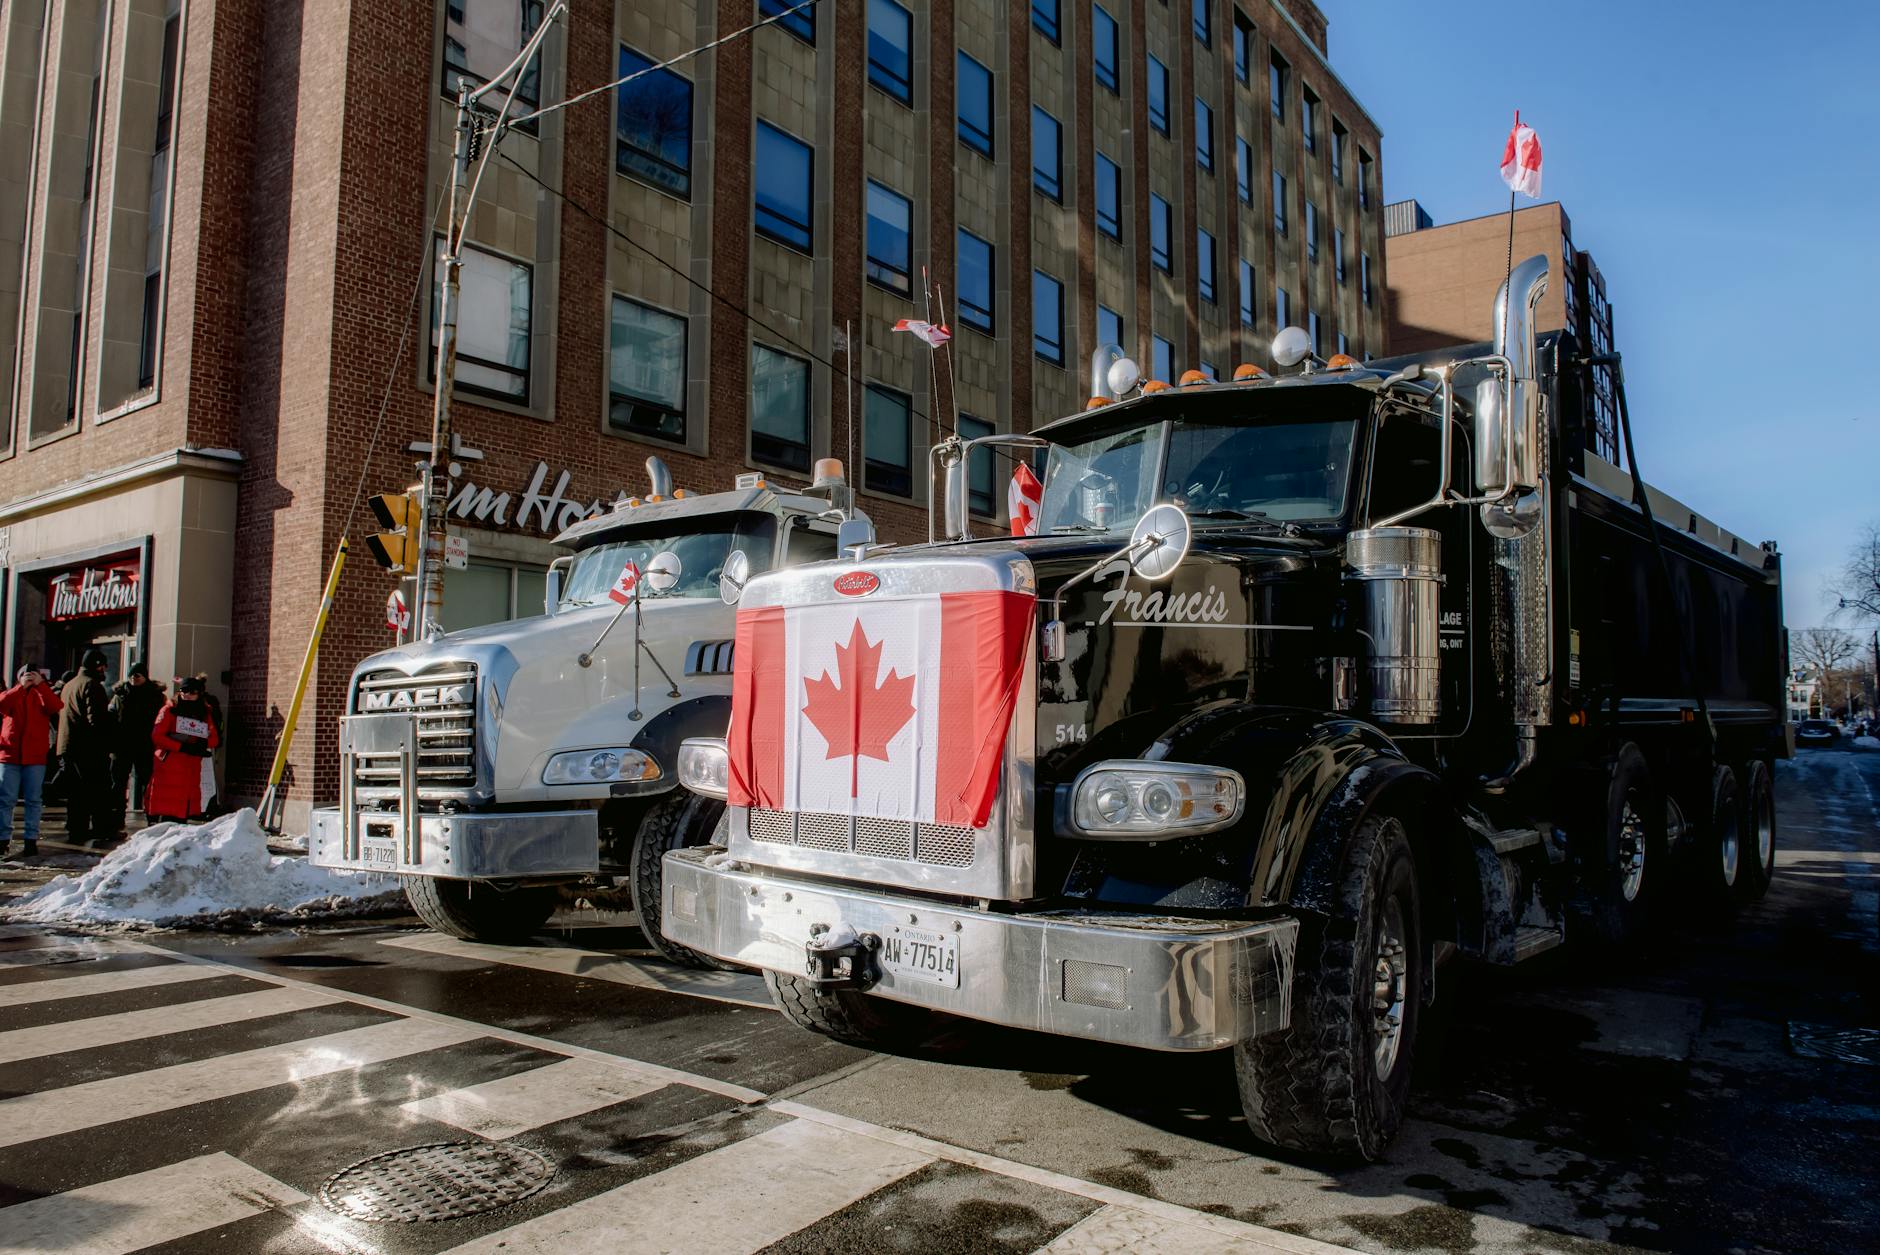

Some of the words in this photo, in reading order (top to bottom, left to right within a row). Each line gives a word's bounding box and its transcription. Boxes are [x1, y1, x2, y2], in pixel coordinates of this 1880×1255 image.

[453, 538, 461, 546] NO
[51, 572, 77, 618] Tim
[79, 567, 138, 613] Hortons
[1093, 560, 1229, 626] Francis
[1450, 639, 1463, 649] ONT
[366, 686, 464, 709] MACK
[1055, 725, 1088, 743] 514
